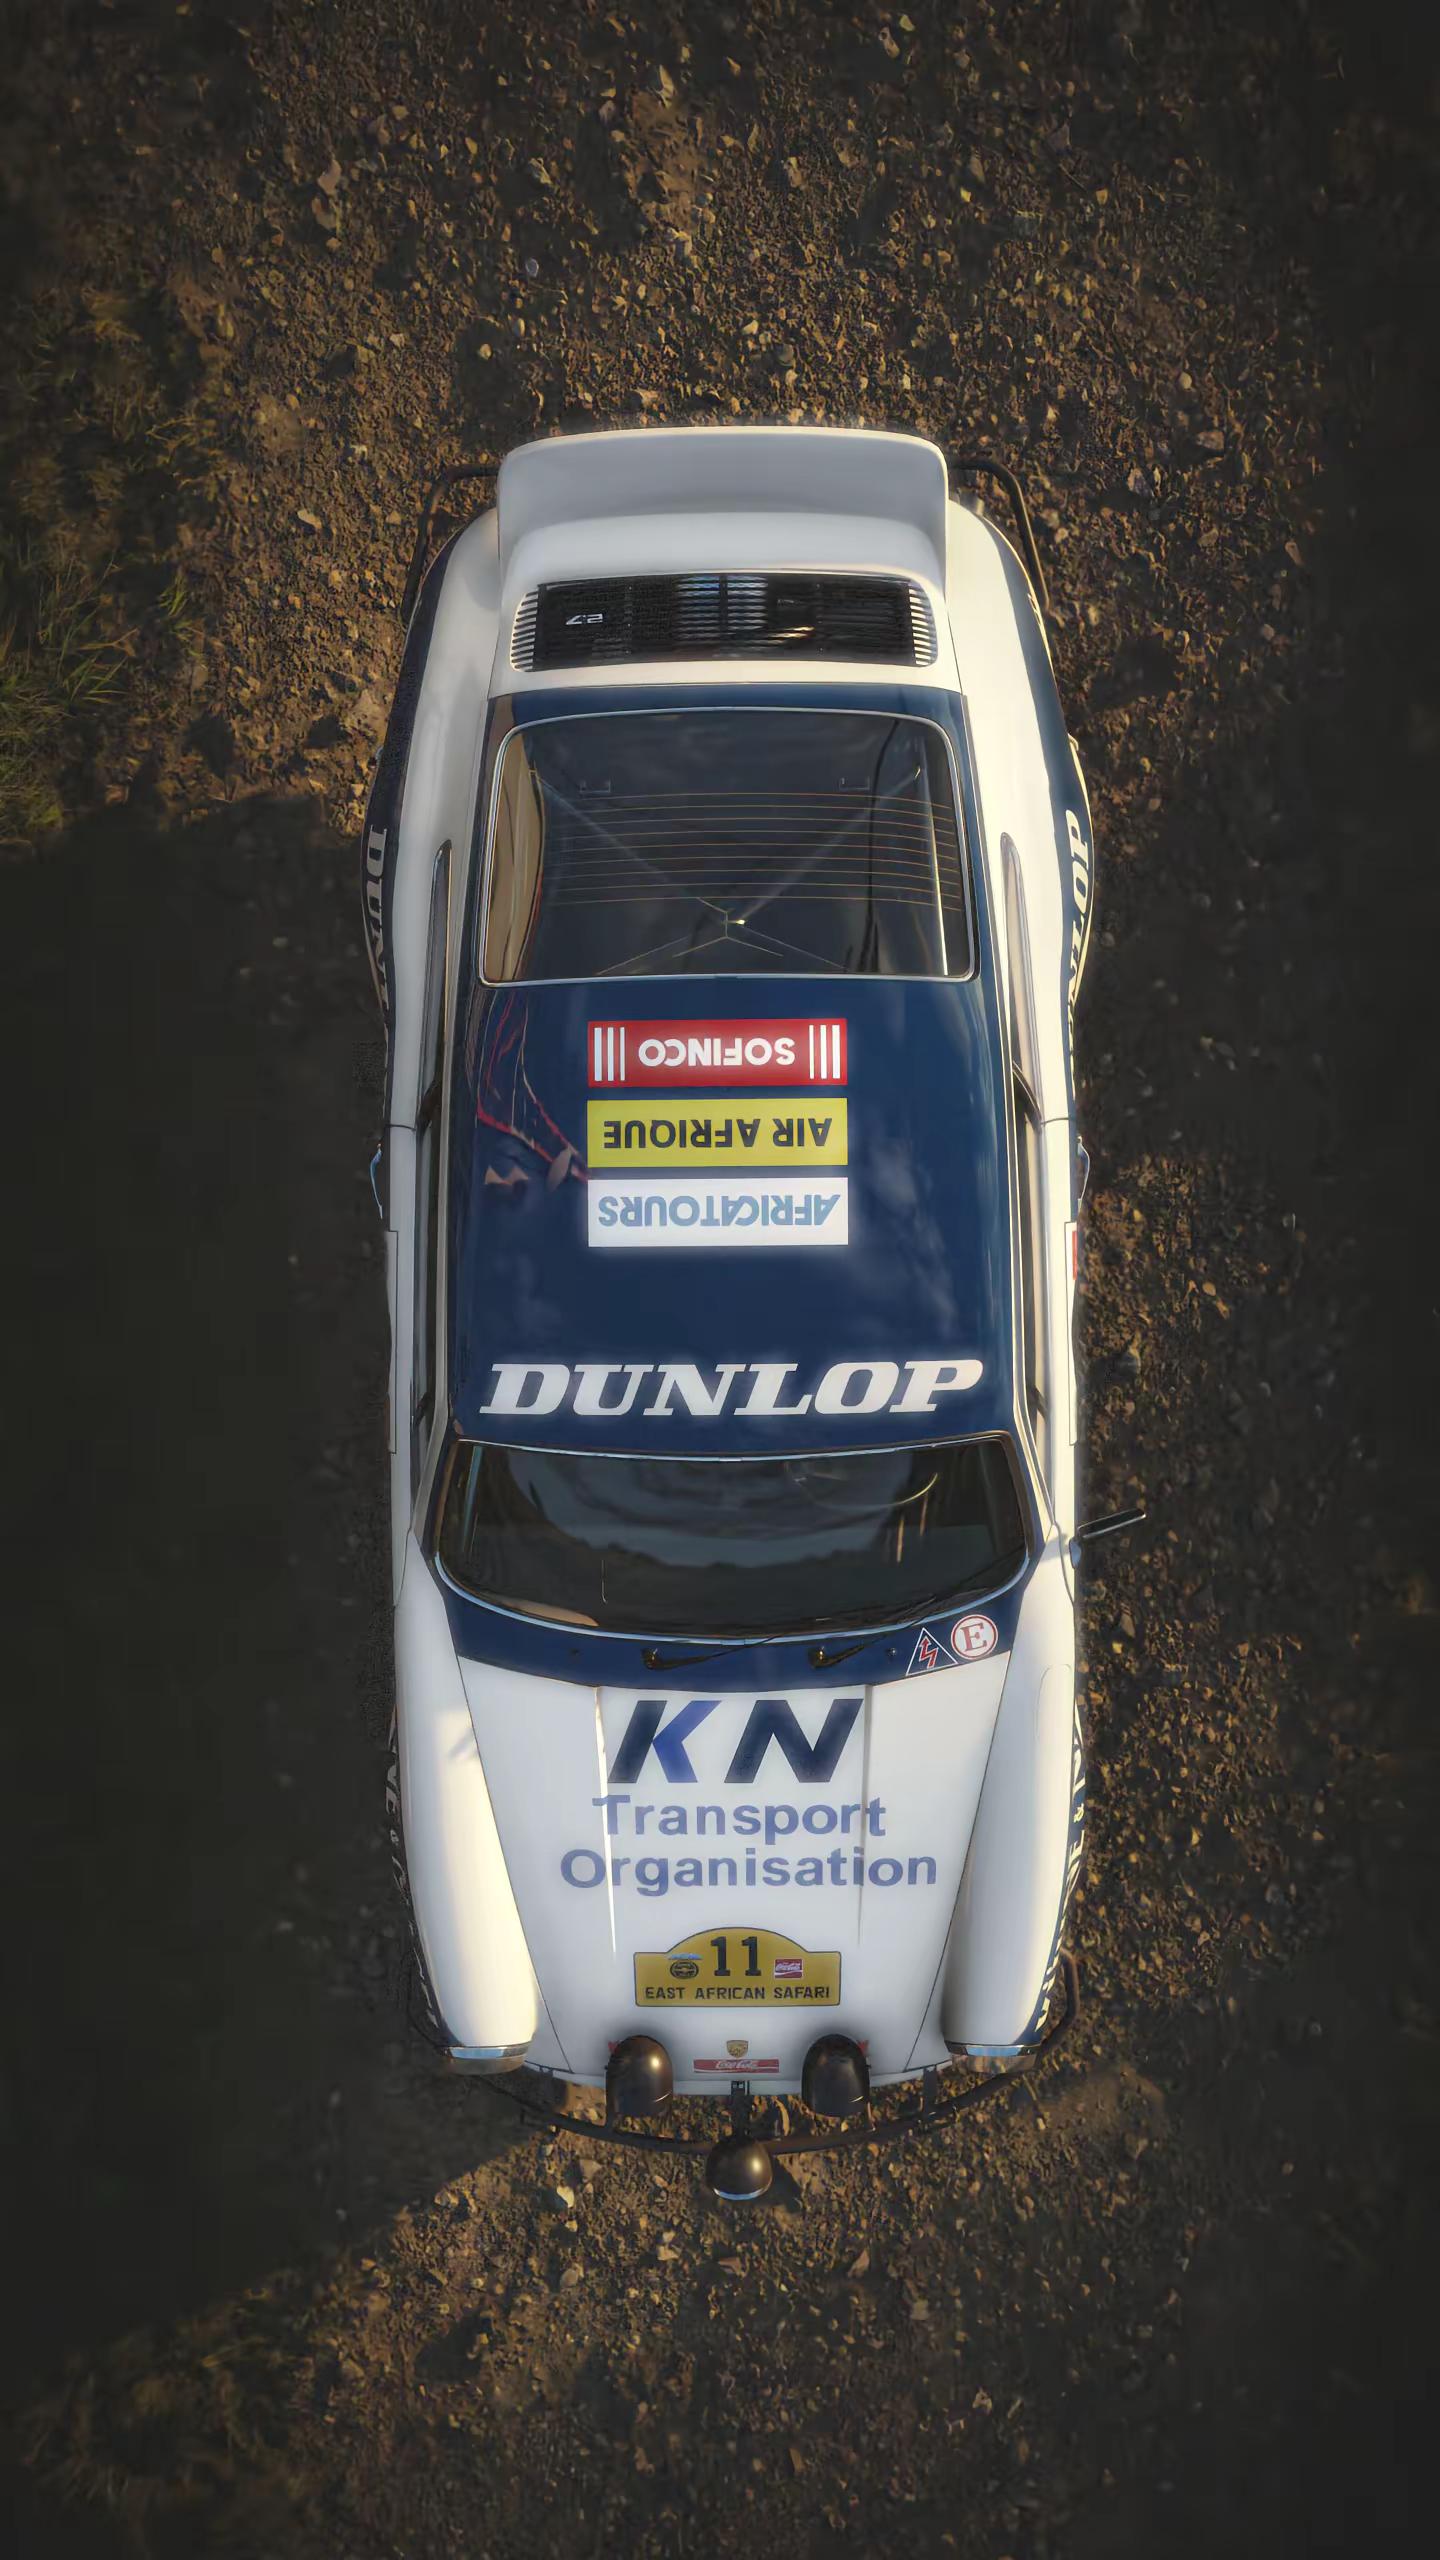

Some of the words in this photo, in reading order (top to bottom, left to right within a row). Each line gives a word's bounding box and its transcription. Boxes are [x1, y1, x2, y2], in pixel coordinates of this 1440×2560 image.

[637, 1037, 796, 1067] SOFINCO
[603, 1118, 761, 1150] AFRIQUE
[772, 1117, 833, 1148] AIR
[598, 1194, 841, 1228] AFRICATOURS
[479, 1359, 984, 1417] DUNLOP
[592, 1794, 886, 1846] Transport
[560, 1846, 937, 1897] Organisation
[710, 1936, 761, 1977] 11
[645, 1986, 685, 2000] EAST
[695, 1986, 766, 2000] AFRICAN
[773, 1986, 830, 2000] SAFARI
